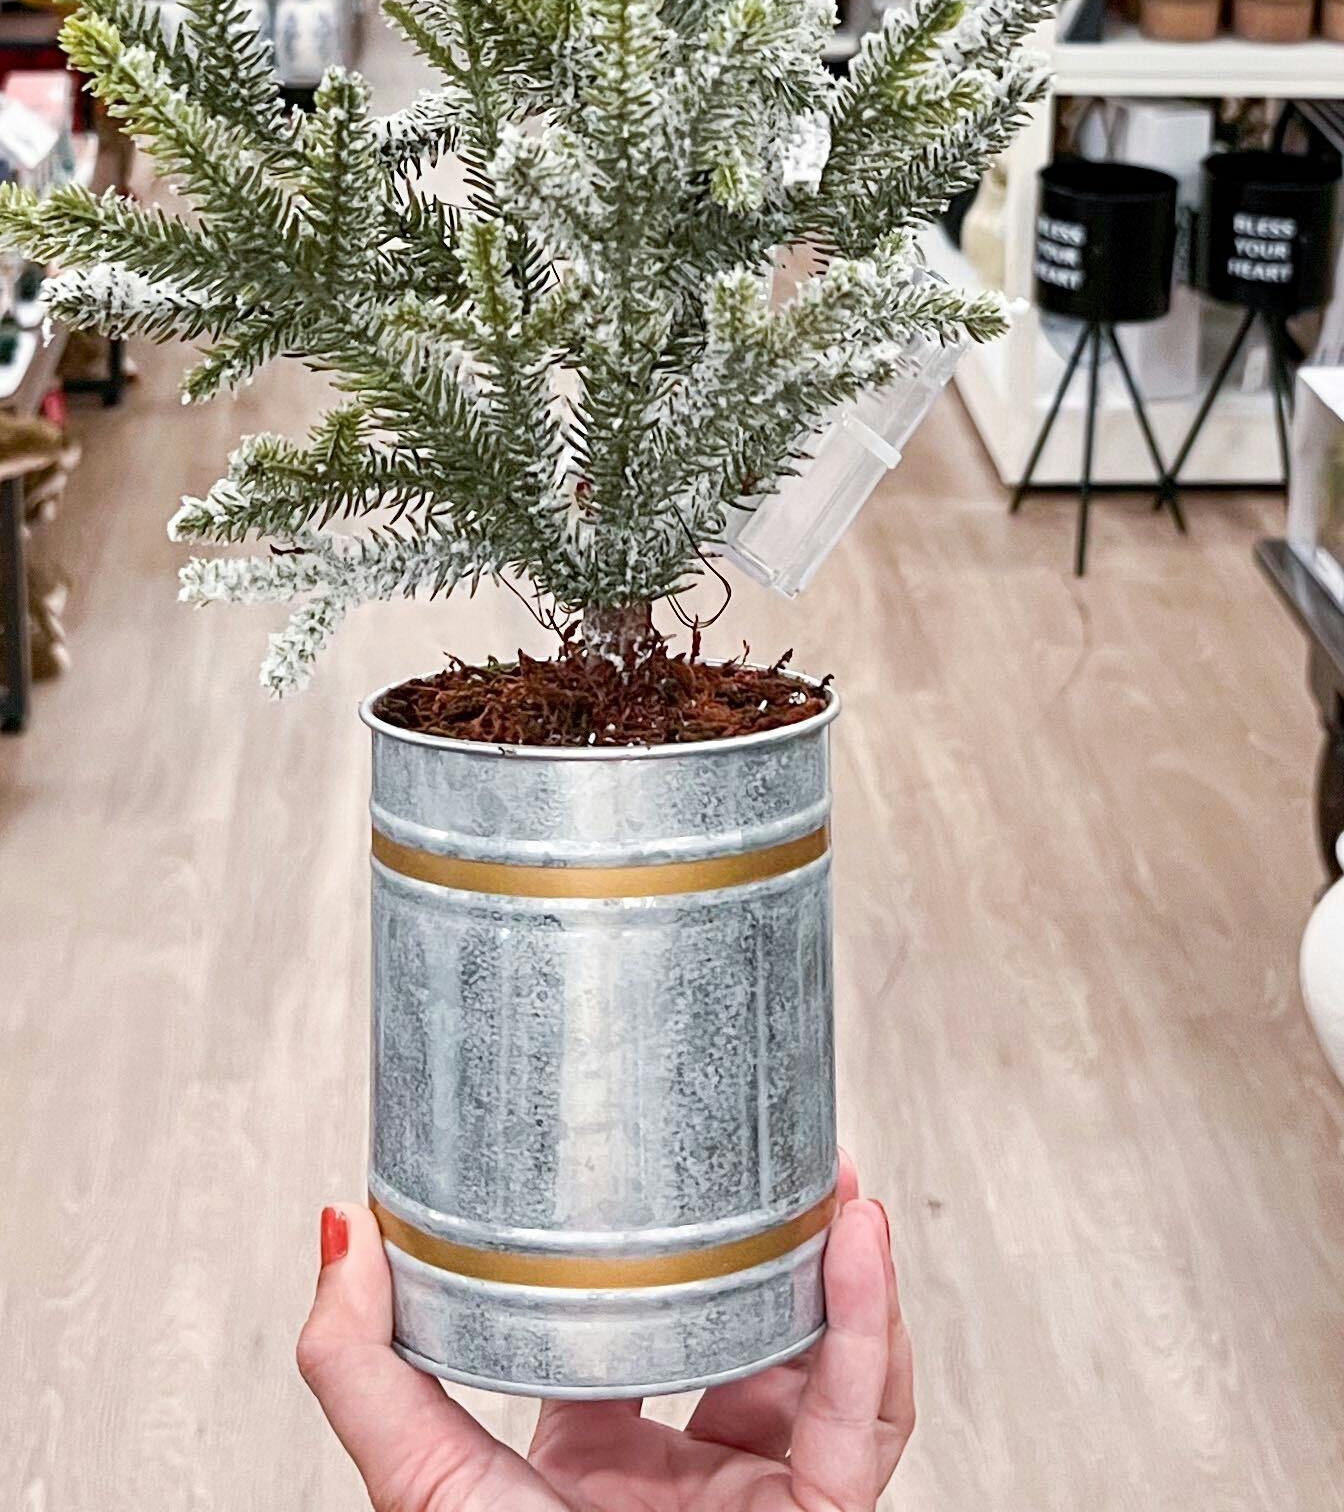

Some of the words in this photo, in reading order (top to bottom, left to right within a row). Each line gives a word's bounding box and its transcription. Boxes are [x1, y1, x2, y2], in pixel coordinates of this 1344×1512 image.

[1233, 213, 1298, 239] BLESS
[1234, 236, 1292, 261] YOUR
[1227, 257, 1294, 284] HEART
